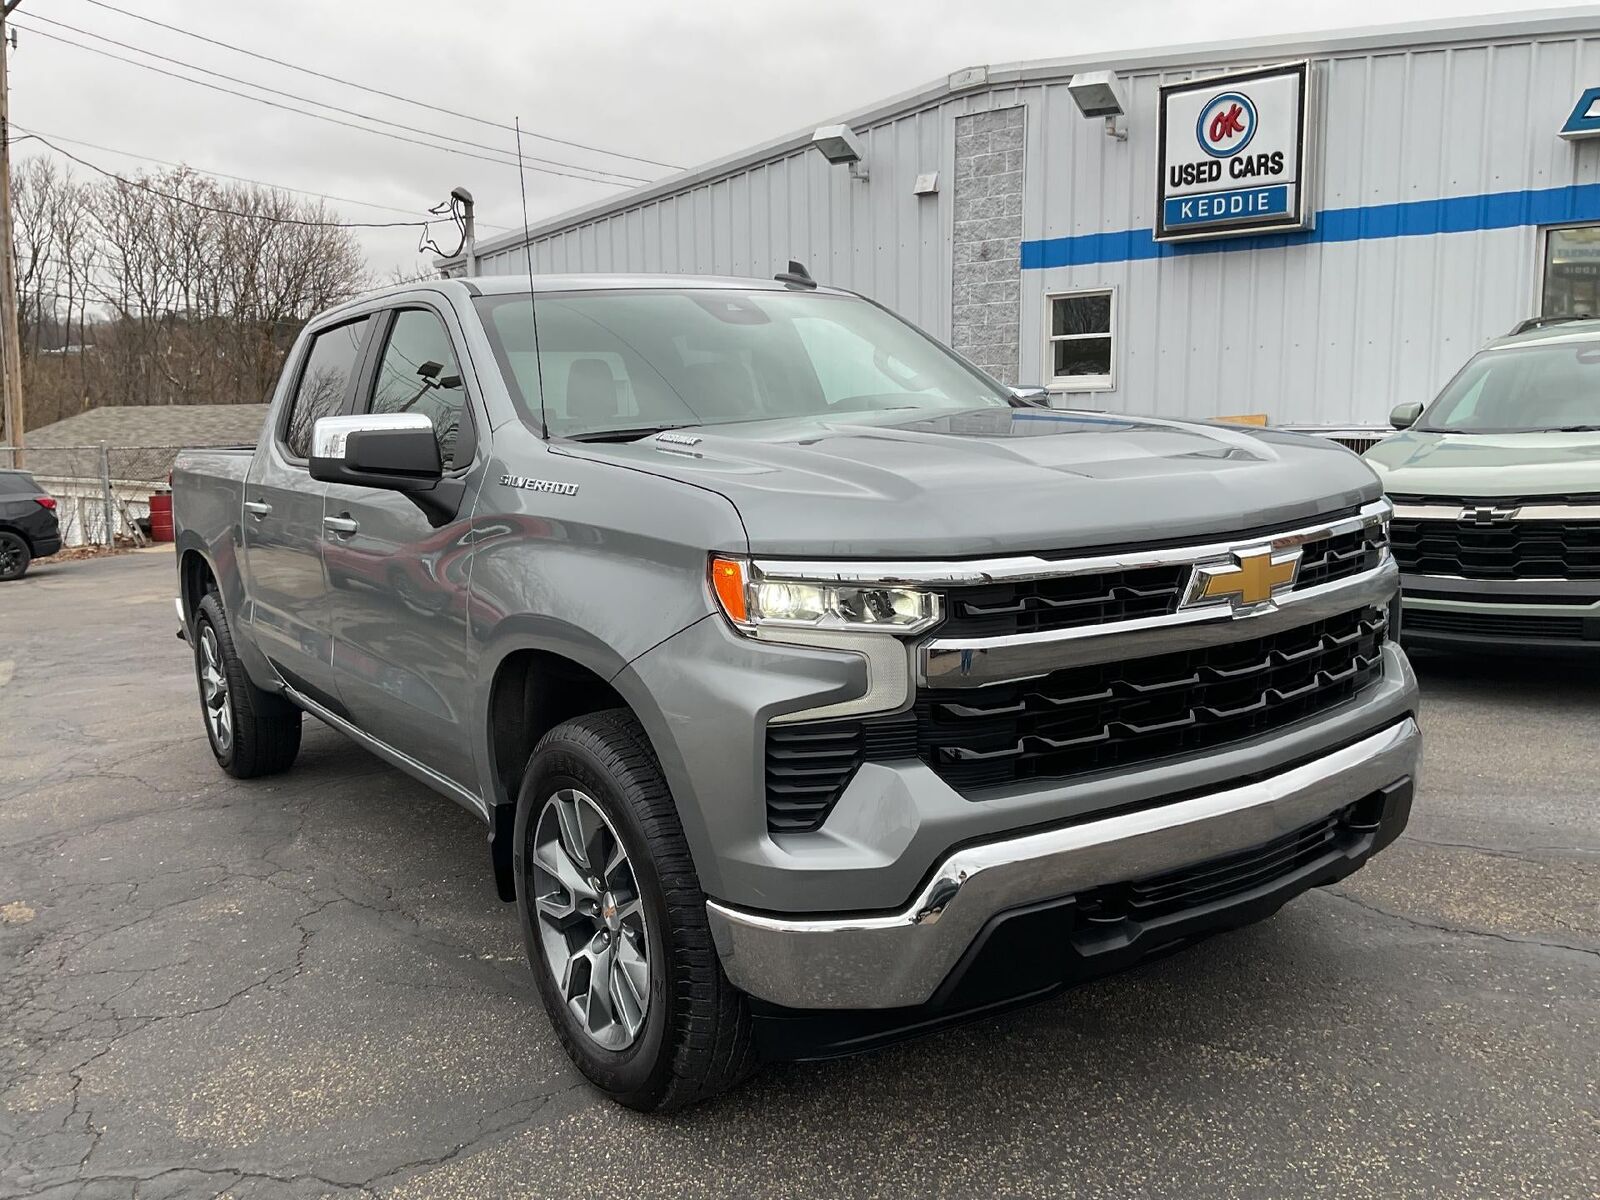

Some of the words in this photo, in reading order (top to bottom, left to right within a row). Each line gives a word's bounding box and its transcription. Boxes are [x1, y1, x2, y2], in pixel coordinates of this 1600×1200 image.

[1210, 104, 1245, 142] OK
[1170, 160, 1221, 187] USED
[1230, 152, 1284, 179] CARS
[1182, 193, 1269, 218] KEDDIE
[499, 474, 578, 496] SILVERADO
